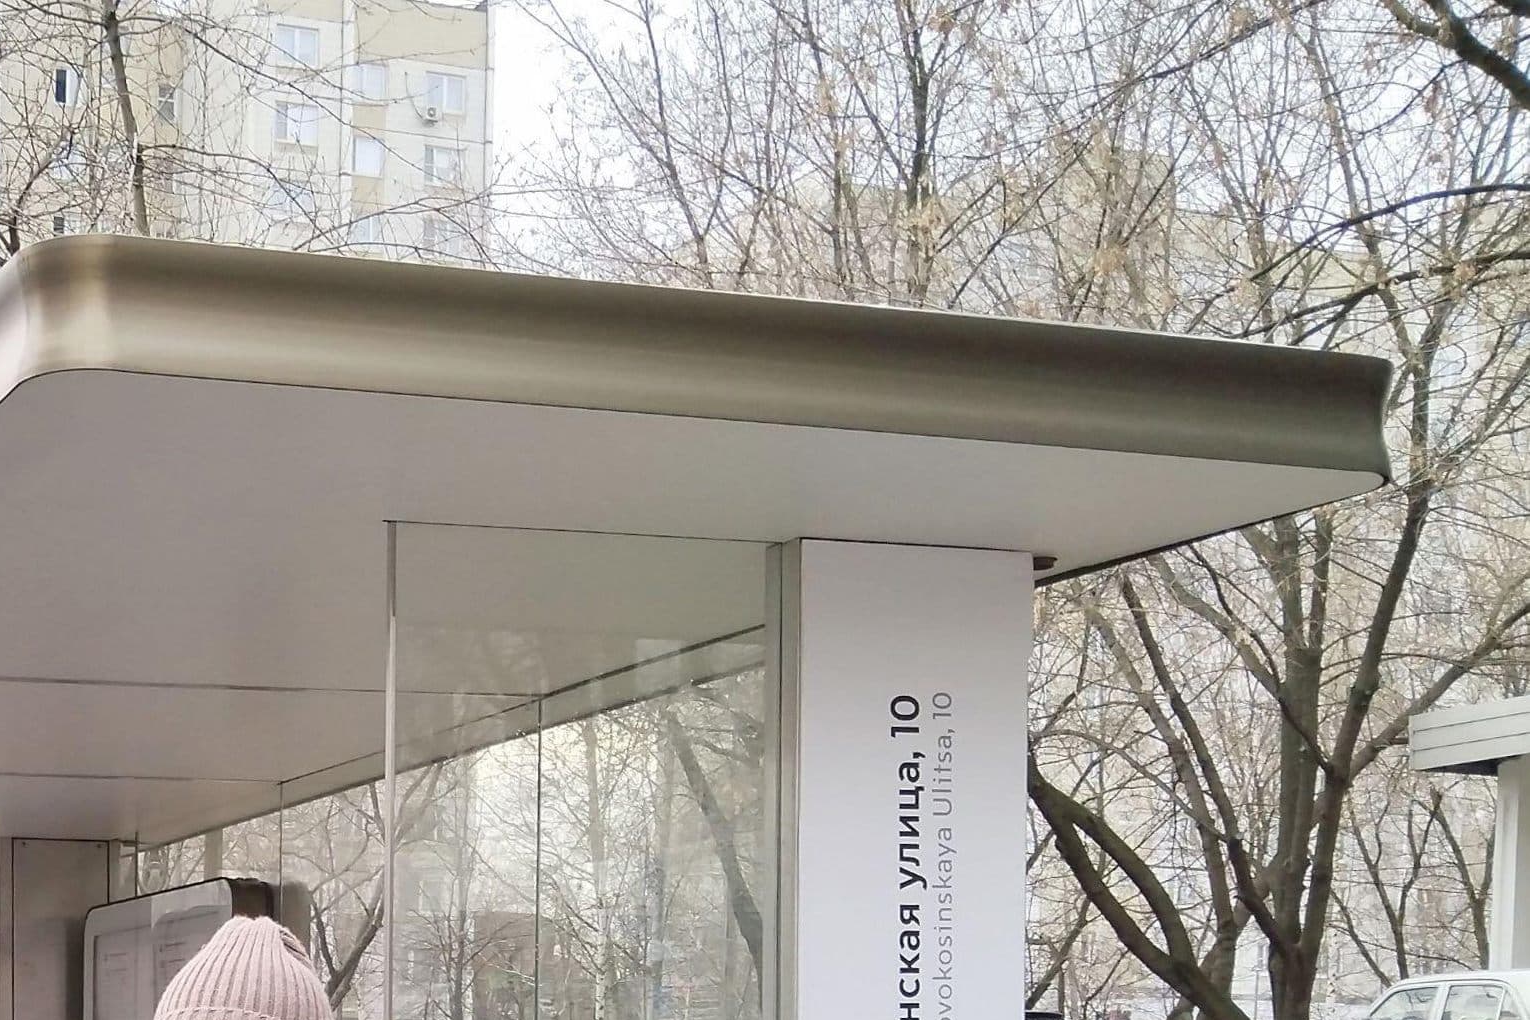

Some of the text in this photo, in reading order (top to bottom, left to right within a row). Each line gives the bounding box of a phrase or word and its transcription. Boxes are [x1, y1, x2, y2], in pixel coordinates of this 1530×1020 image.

[889, 694, 921, 739] 10
[931, 692, 953, 720] 10
[931, 728, 956, 818] Ulitsa,
[896, 751, 928, 891] улица,
